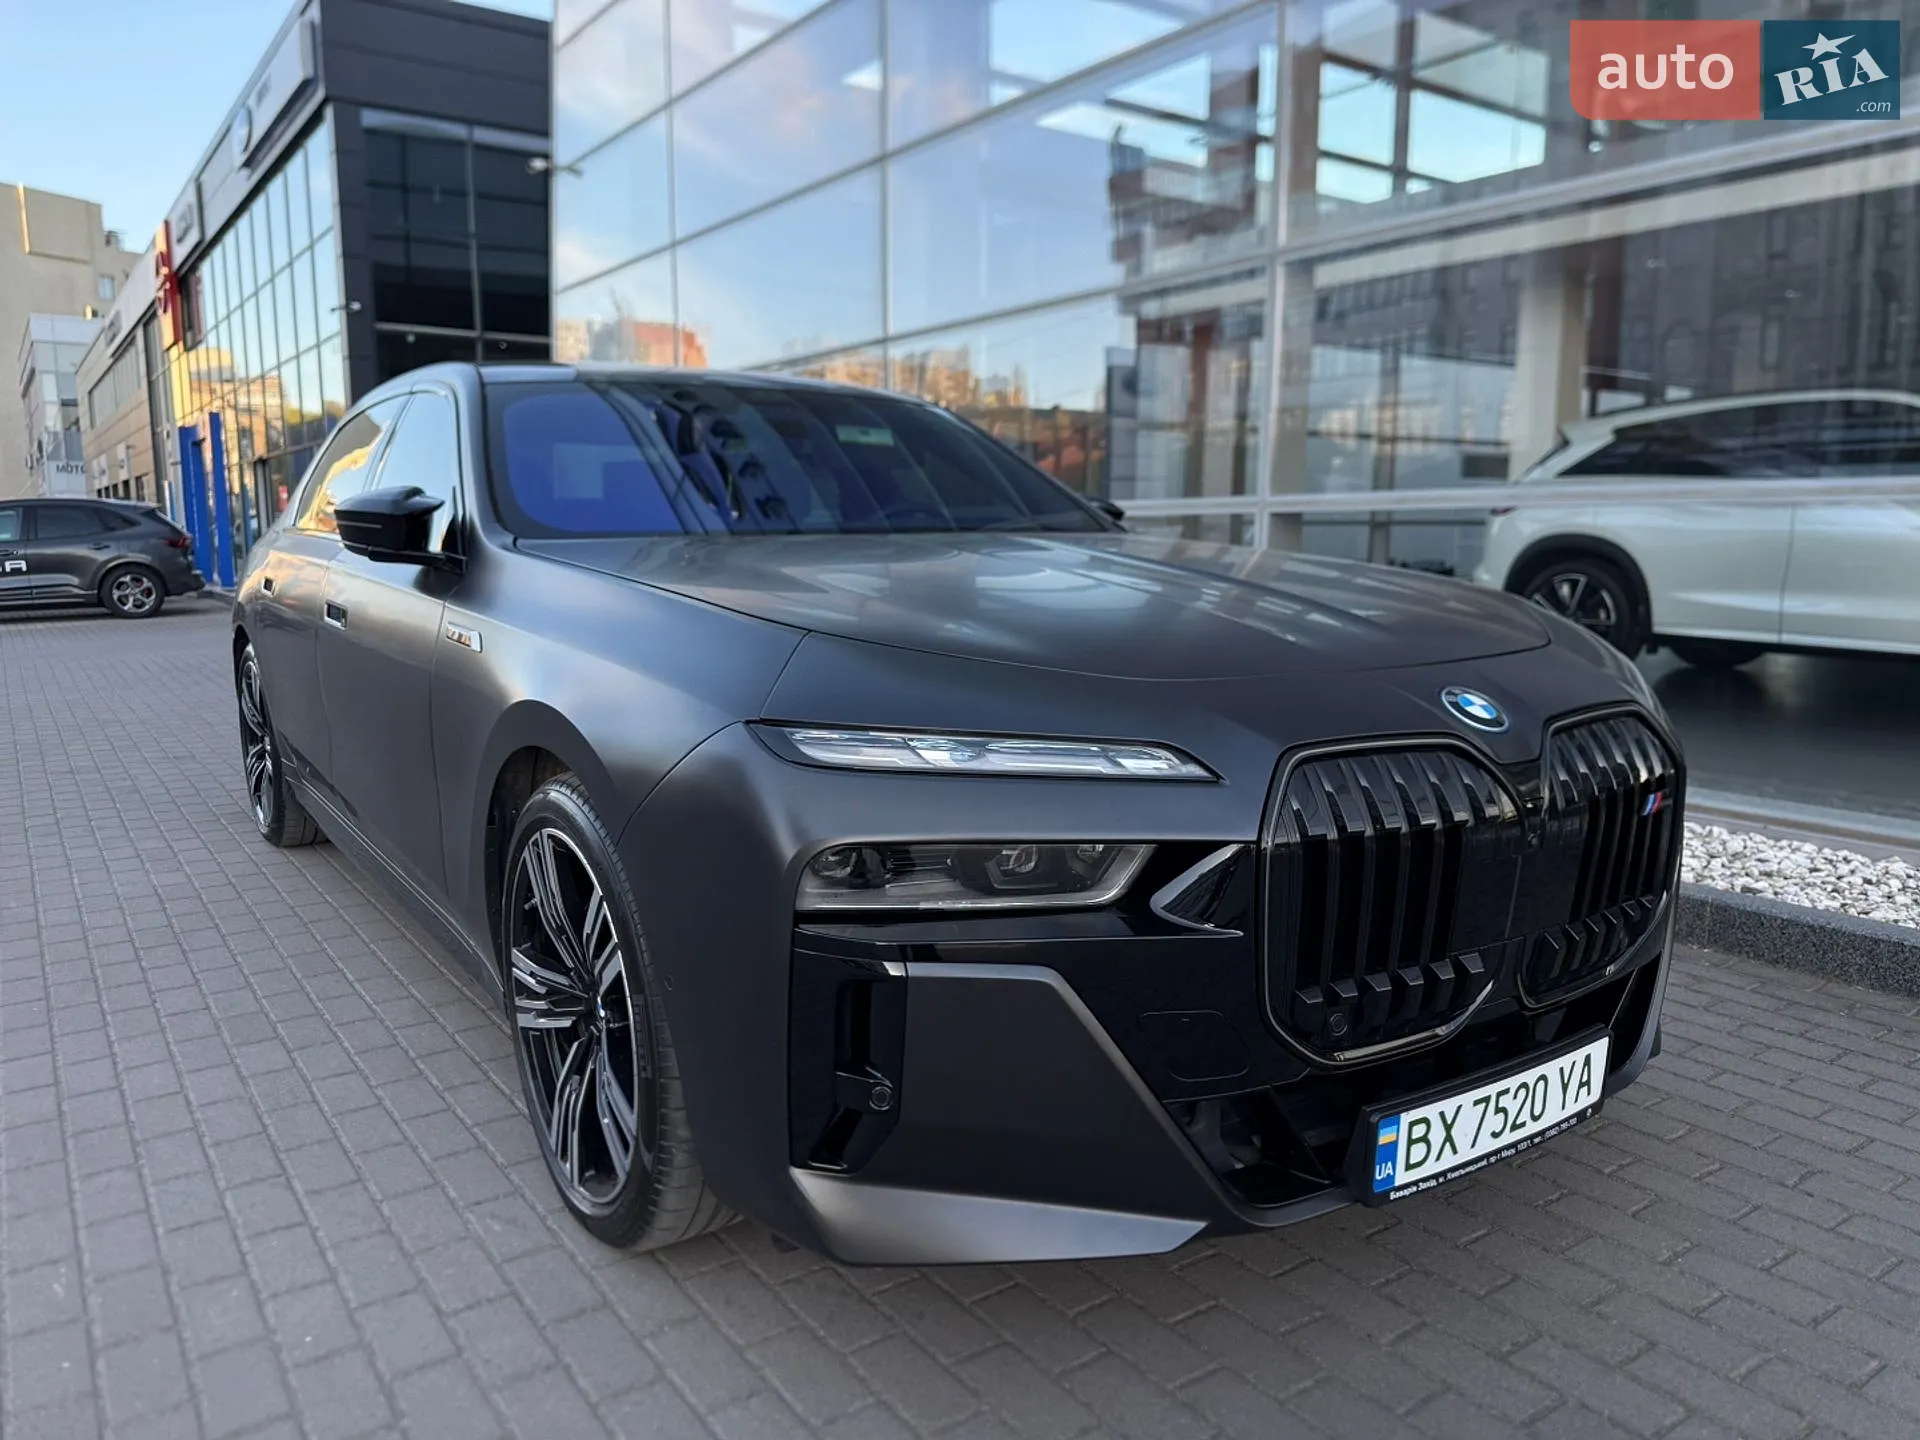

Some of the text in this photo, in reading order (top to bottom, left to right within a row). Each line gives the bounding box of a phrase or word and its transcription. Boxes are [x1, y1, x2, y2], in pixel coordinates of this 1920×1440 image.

[1404, 1052, 1592, 1172] BX 7520 YA
[1375, 1160, 1394, 1180] UA
